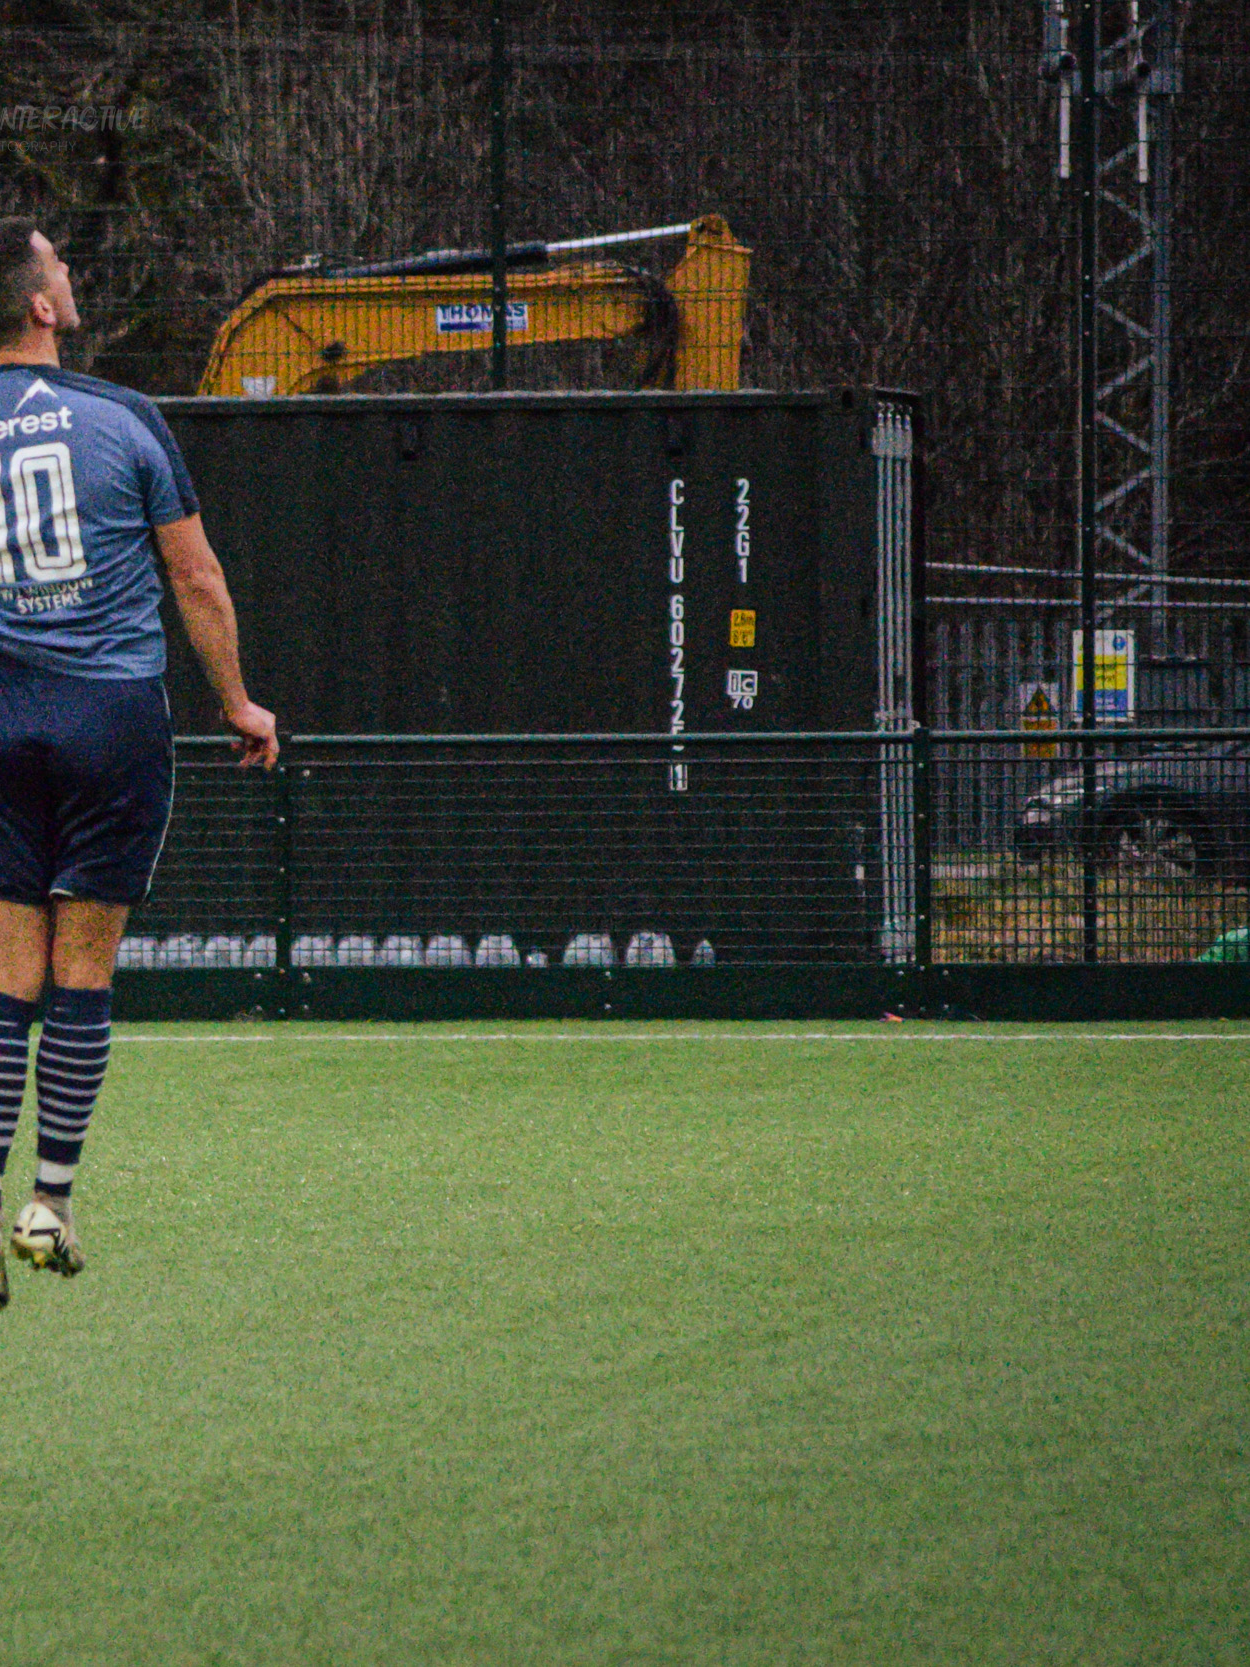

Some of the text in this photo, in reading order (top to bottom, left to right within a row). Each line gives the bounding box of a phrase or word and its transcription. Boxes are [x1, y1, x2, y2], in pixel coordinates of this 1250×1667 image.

[669, 479, 685, 584] CLVU
[736, 478, 750, 583] 22G1
[16, 591, 83, 614] SYSTEMS
[732, 696, 754, 710] 70
